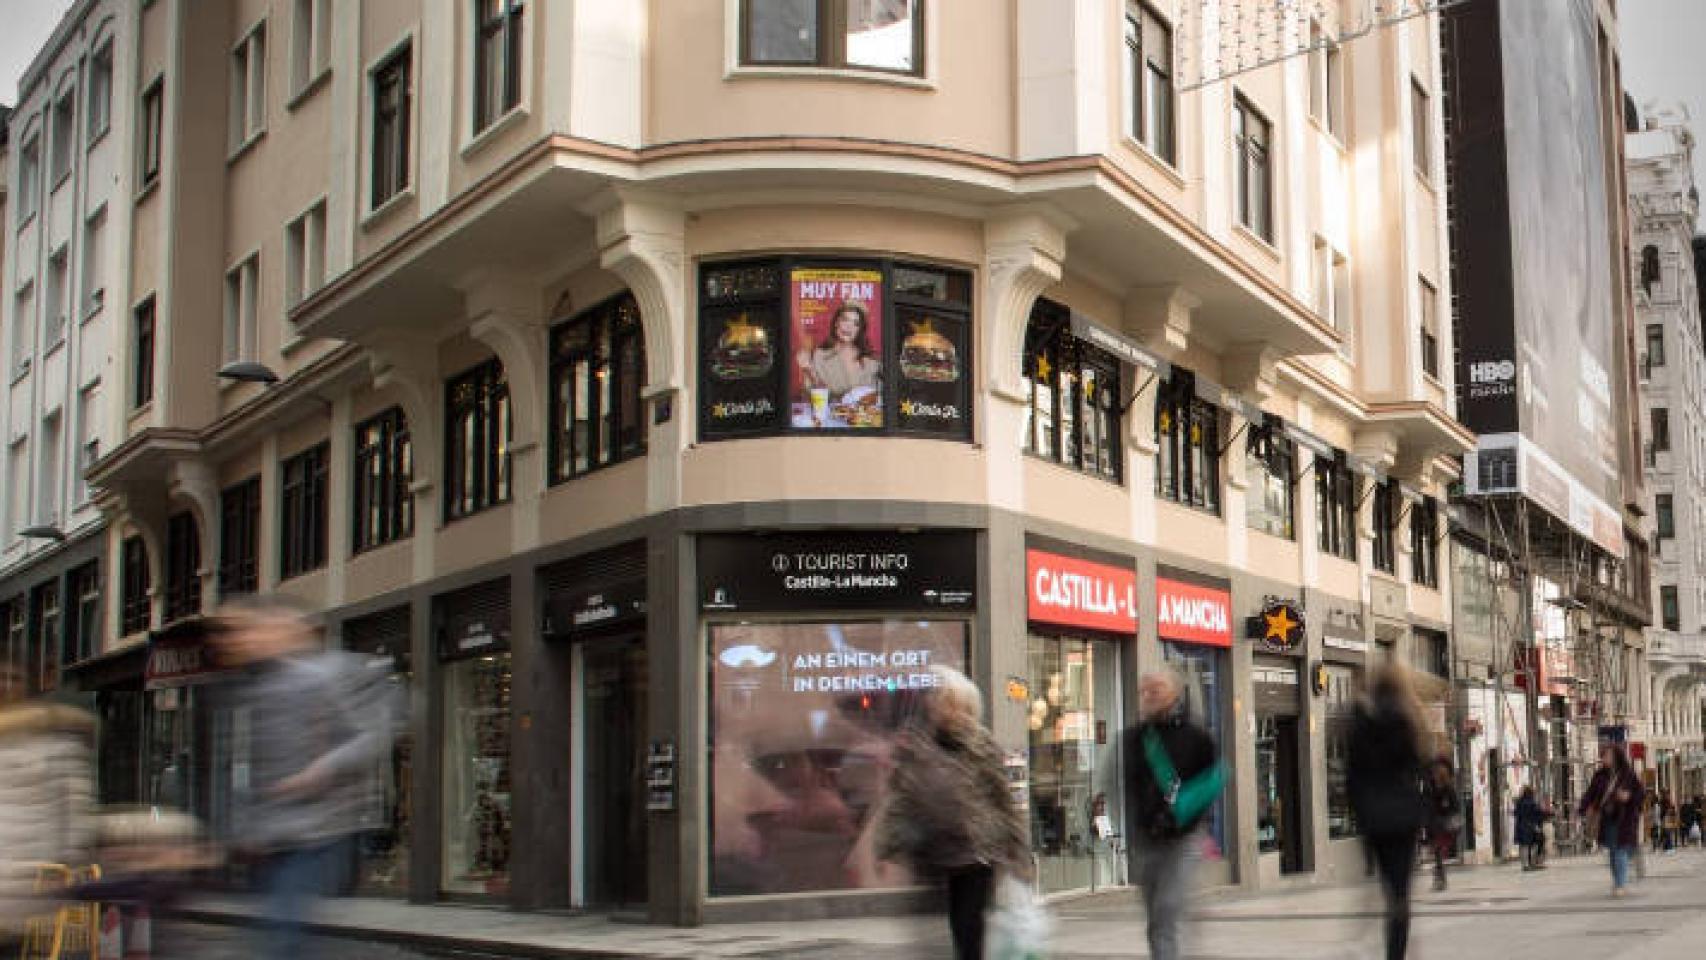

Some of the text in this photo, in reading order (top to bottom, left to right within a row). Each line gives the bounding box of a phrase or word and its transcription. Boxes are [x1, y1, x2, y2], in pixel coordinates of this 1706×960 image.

[801, 281, 874, 298] MUY FAN
[1470, 360, 1514, 382] HBO
[795, 554, 908, 570] TOURIST INFO
[851, 574, 898, 587] Mancha
[1172, 595, 1227, 632] MANCHA
[794, 650, 929, 668] AN EINEM ORT
[794, 673, 947, 692] IN DEINEM LEBE
